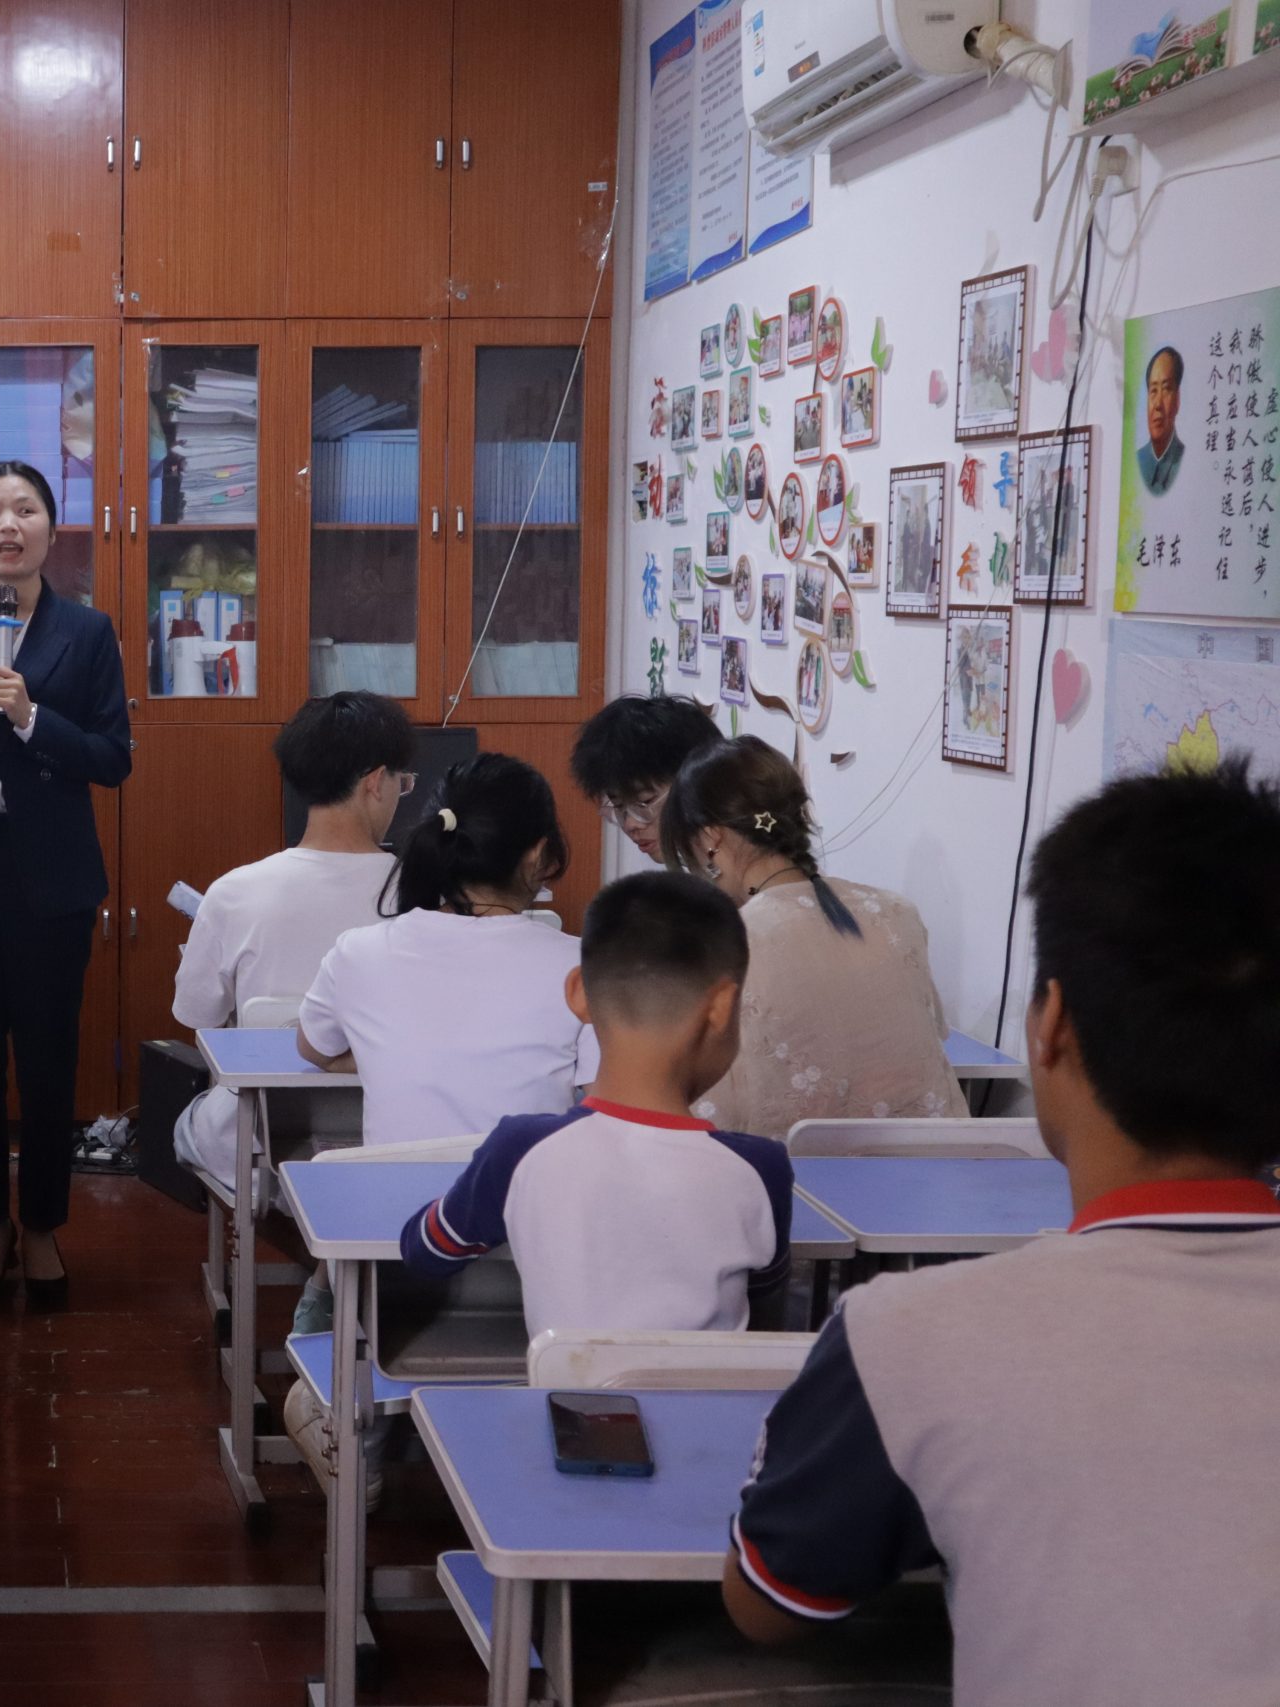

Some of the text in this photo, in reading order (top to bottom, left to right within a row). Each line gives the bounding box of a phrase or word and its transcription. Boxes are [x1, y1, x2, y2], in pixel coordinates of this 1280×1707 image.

[1216, 328, 1243, 581] 我们应当永远记住
[1136, 534, 1181, 569] 毛泽东
